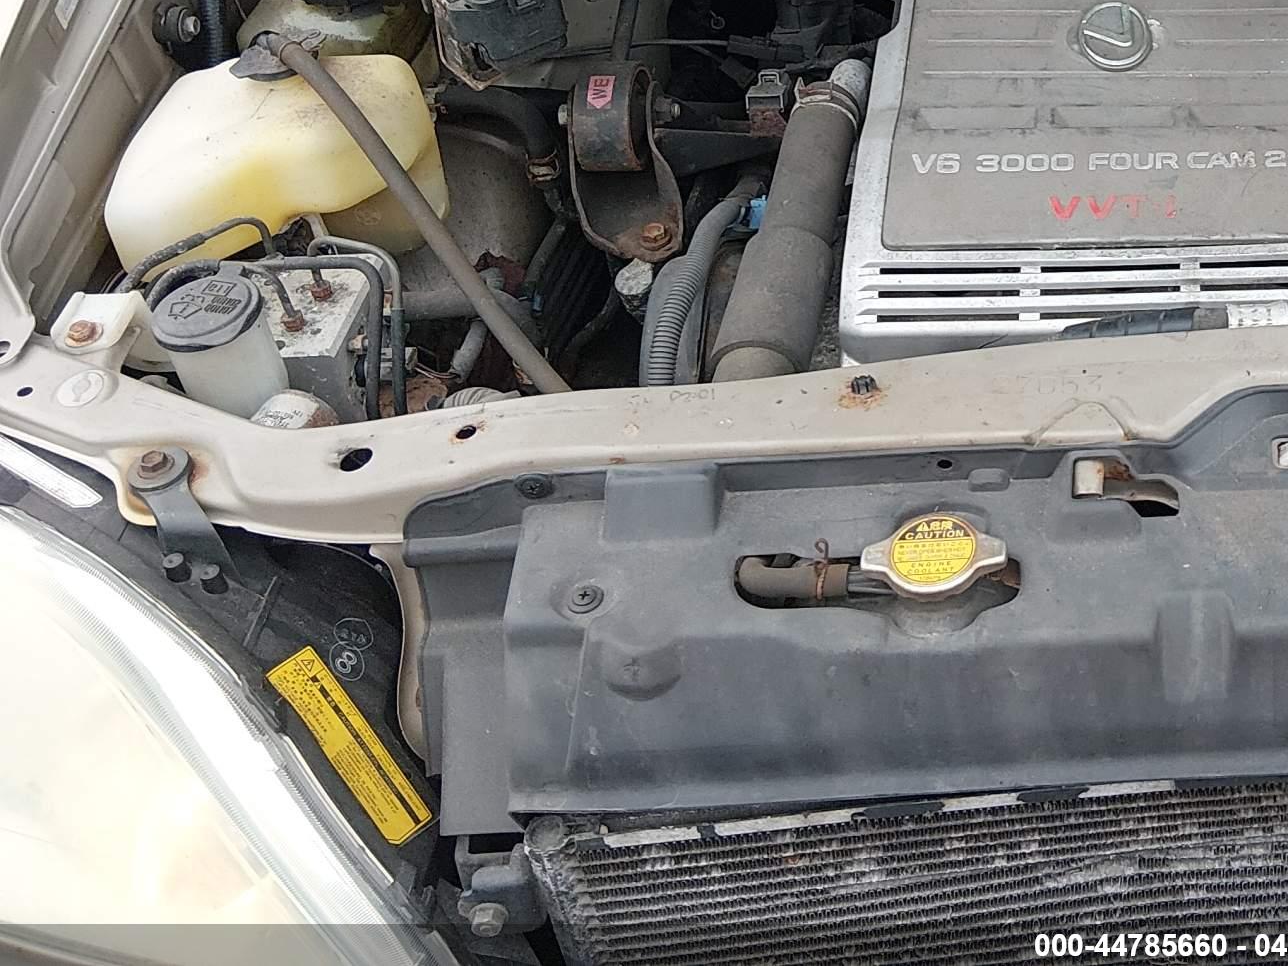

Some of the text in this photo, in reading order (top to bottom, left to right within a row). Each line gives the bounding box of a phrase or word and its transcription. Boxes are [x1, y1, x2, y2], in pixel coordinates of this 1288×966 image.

[911, 153, 961, 174] V6
[975, 153, 1075, 173] 3000
[1088, 151, 1180, 171] FOUR
[1186, 151, 1257, 170] CAM
[905, 530, 964, 540] CAUTION
[911, 560, 952, 568] ENGINE
[907, 566, 955, 574] COOLANT
